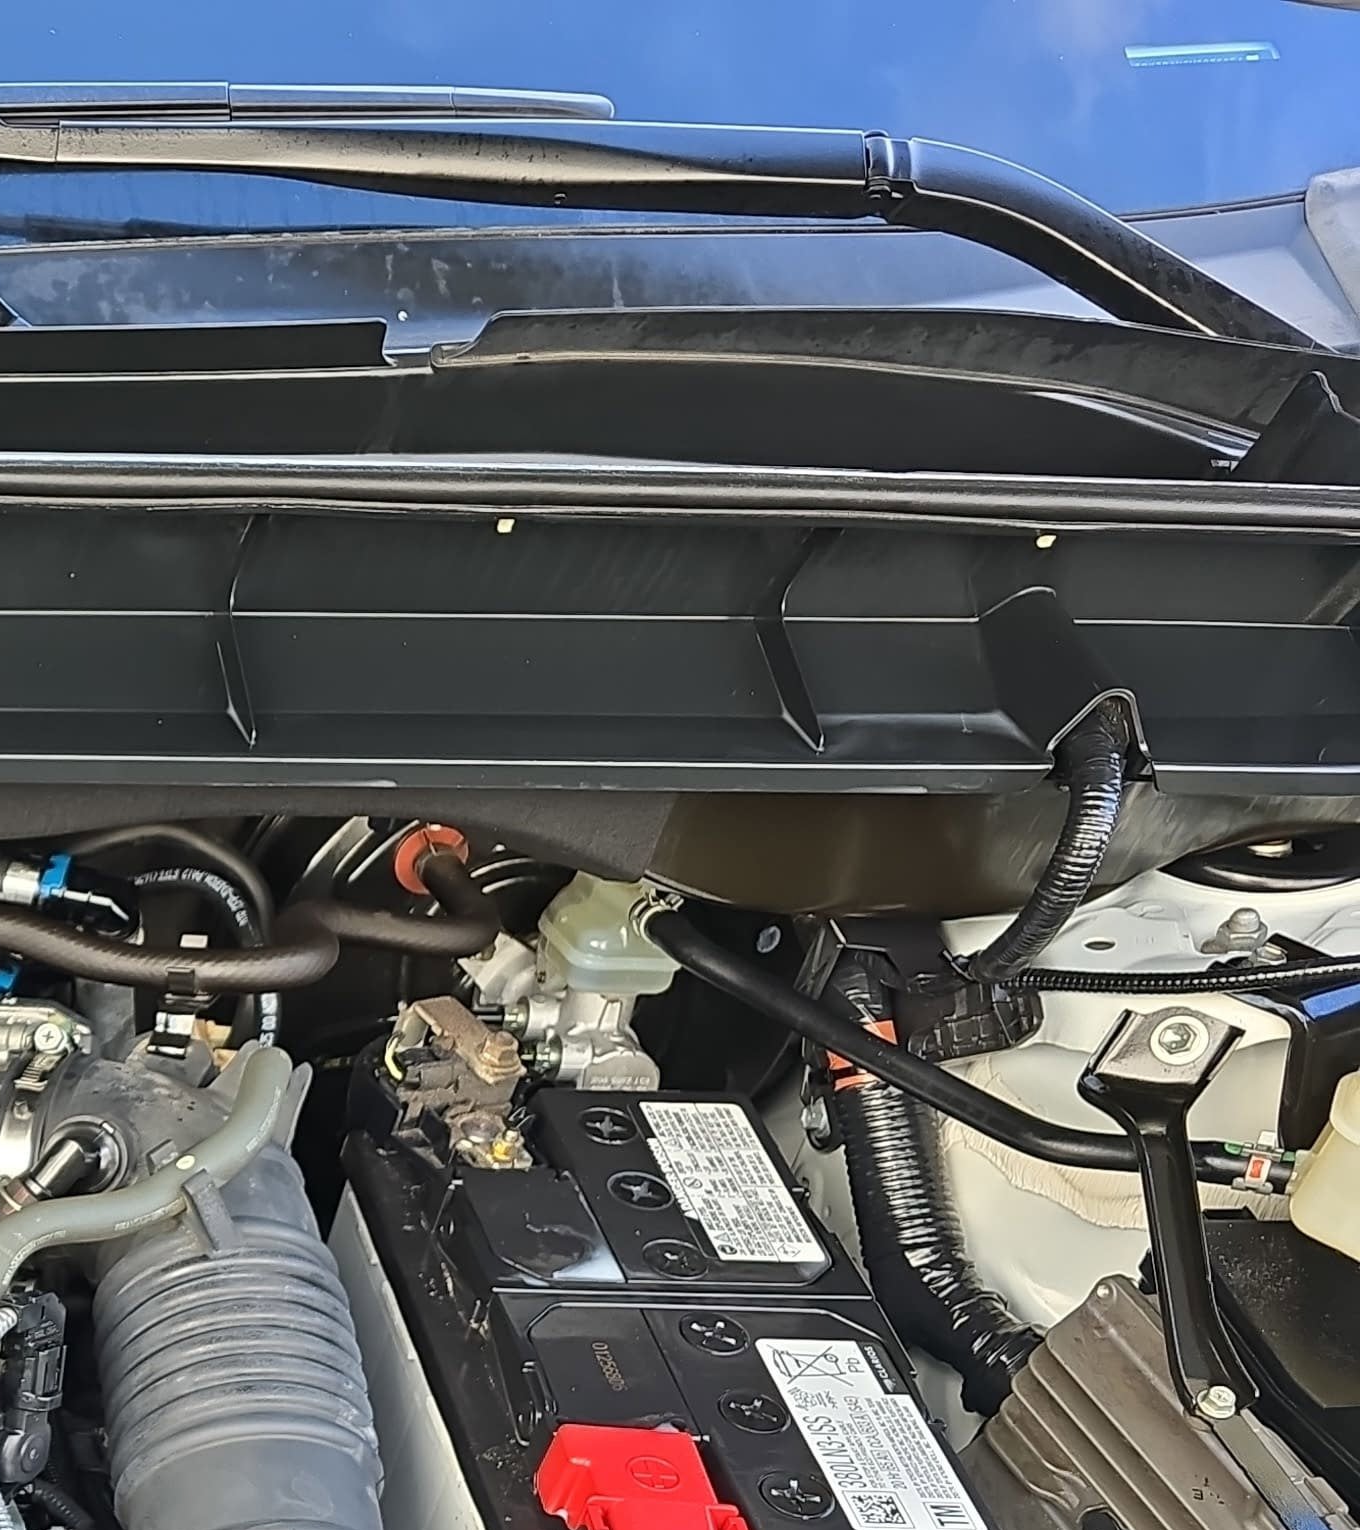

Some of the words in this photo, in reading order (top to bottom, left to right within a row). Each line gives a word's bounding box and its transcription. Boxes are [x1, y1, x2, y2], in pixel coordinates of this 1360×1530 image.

[847, 1357, 864, 1373] Pb
[864, 1345, 889, 1378] CLARIOS
[802, 1415, 868, 1488] 380LN3-ISS
[929, 1504, 970, 1526] TM
